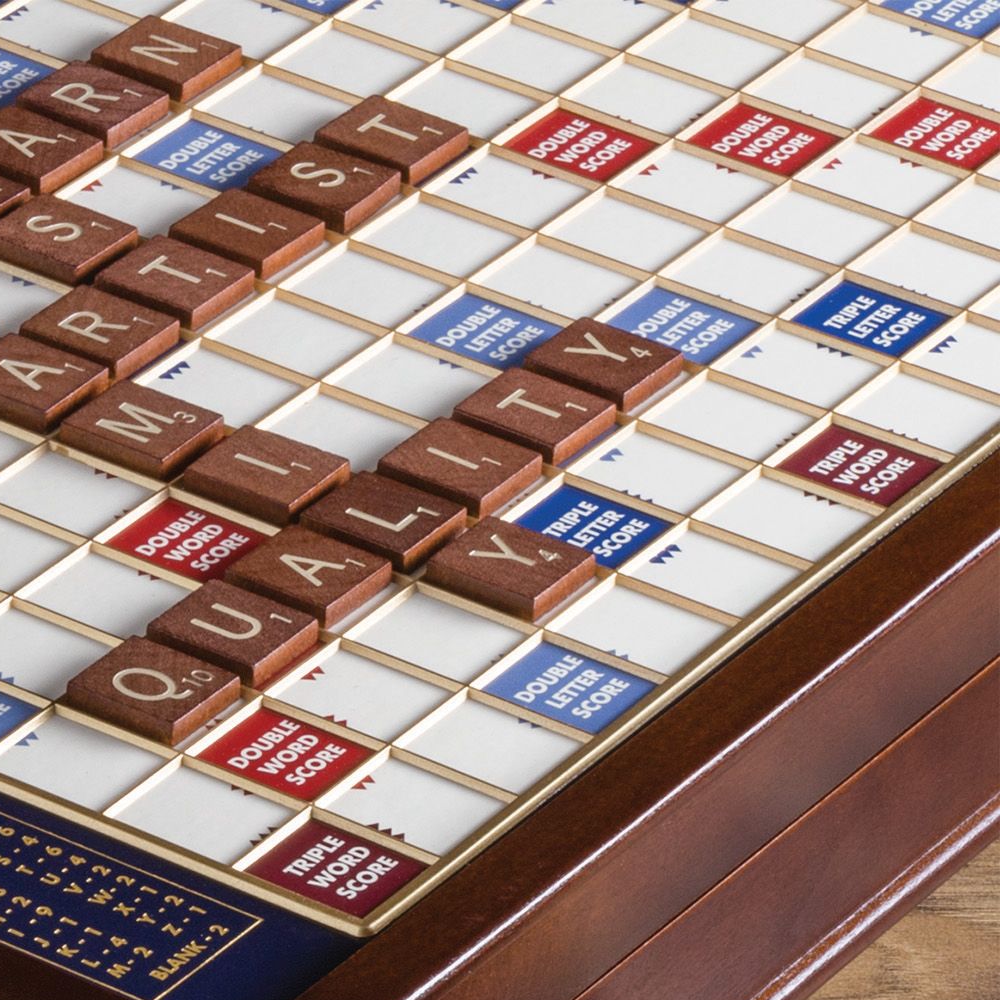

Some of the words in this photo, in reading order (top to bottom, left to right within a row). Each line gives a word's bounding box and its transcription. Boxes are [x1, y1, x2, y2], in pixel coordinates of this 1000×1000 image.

[527, 118, 591, 159] DOUBLE
[711, 113, 773, 154] DOUBLE
[737, 125, 790, 158] WORD
[893, 107, 955, 147] DOUBLE
[920, 119, 972, 152] WORD
[945, 126, 998, 161] SCORE
[158, 130, 224, 170] DOUBLE
[185, 142, 241, 175] LETTER
[553, 131, 608, 163] WORD
[578, 138, 633, 173] SCORE
[762, 132, 815, 167] SCORE
[209, 149, 265, 184] SCORE
[435, 304, 502, 348] DOUBLE
[655, 310, 711, 347] LETTER
[822, 295, 877, 329] TRIPLE
[847, 304, 902, 339] LETTER
[872, 311, 926, 348] SCORE
[463, 317, 521, 353] LETTER
[489, 325, 545, 361] SCORE
[680, 318, 735, 355] SCORE
[808, 439, 865, 476] TRIPLE
[832, 448, 889, 485] WORD
[860, 456, 916, 495] SCORE
[134, 510, 206, 557] DOUBLE
[541, 500, 599, 538] TRIPLE
[566, 510, 625, 548] LETTER
[163, 524, 224, 561] WORD
[190, 532, 250, 572] SCORE
[591, 518, 650, 559] SCORE
[514, 655, 584, 703] DOUBLE
[545, 669, 605, 709] LETTER
[571, 678, 631, 719] SCORE
[227, 719, 301, 770] DOUBLE
[256, 734, 319, 775] WORD
[284, 743, 347, 786] SCORE
[282, 835, 346, 877] TRIPLE
[306, 846, 371, 888] WORD
[335, 855, 399, 900] SCORE
